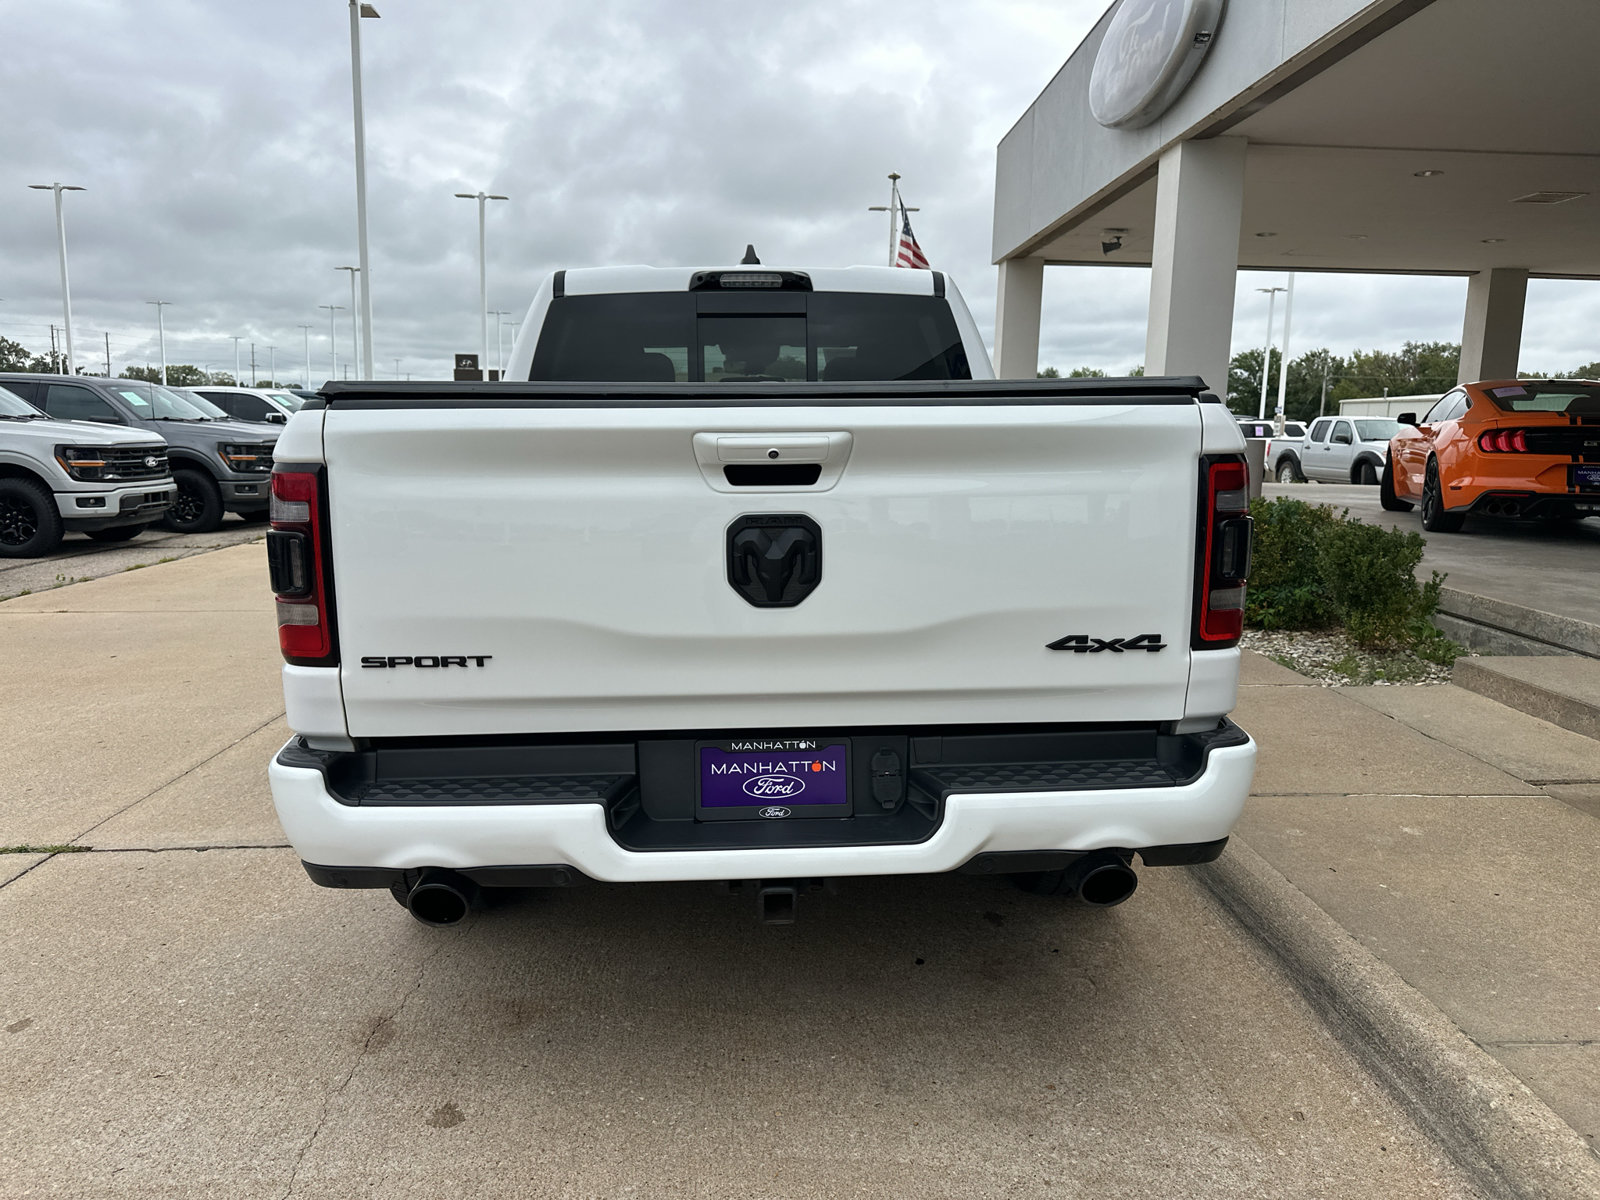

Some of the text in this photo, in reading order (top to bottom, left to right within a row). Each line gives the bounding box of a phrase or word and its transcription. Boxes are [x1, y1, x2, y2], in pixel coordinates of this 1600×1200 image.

[746, 517, 802, 525] RAM
[1045, 634, 1168, 653] 4x4
[361, 655, 493, 668] SPORT
[731, 741, 816, 750] MANHATTN
[711, 760, 836, 775] MANHATTN
[753, 777, 794, 795] Ford
[765, 808, 785, 817] Ford
